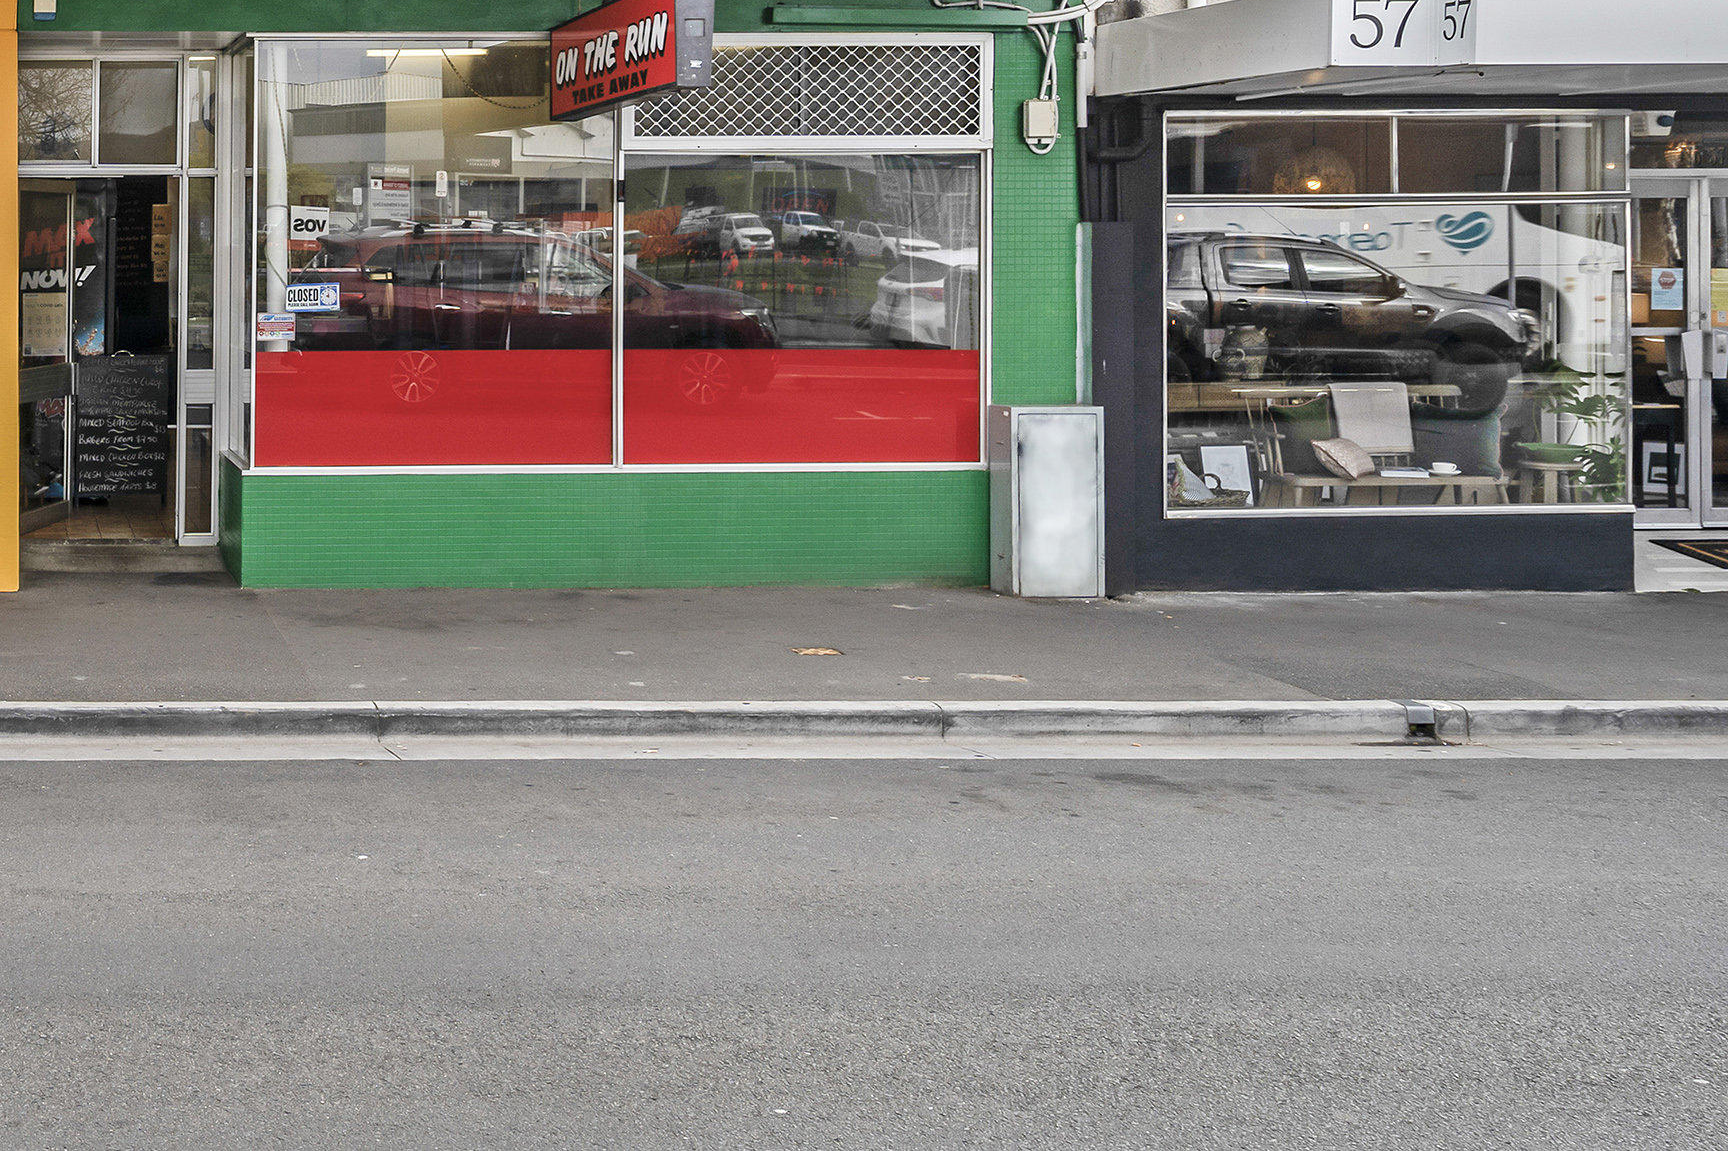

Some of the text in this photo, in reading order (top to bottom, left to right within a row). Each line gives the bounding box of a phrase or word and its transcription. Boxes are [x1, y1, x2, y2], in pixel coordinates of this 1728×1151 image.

[1443, 0, 1471, 40] 57
[556, 11, 668, 90] ON THE RUN
[572, 68, 648, 105] TAKE AWAY
[23, 217, 96, 258] MAX
[287, 288, 319, 303] CLOSED
